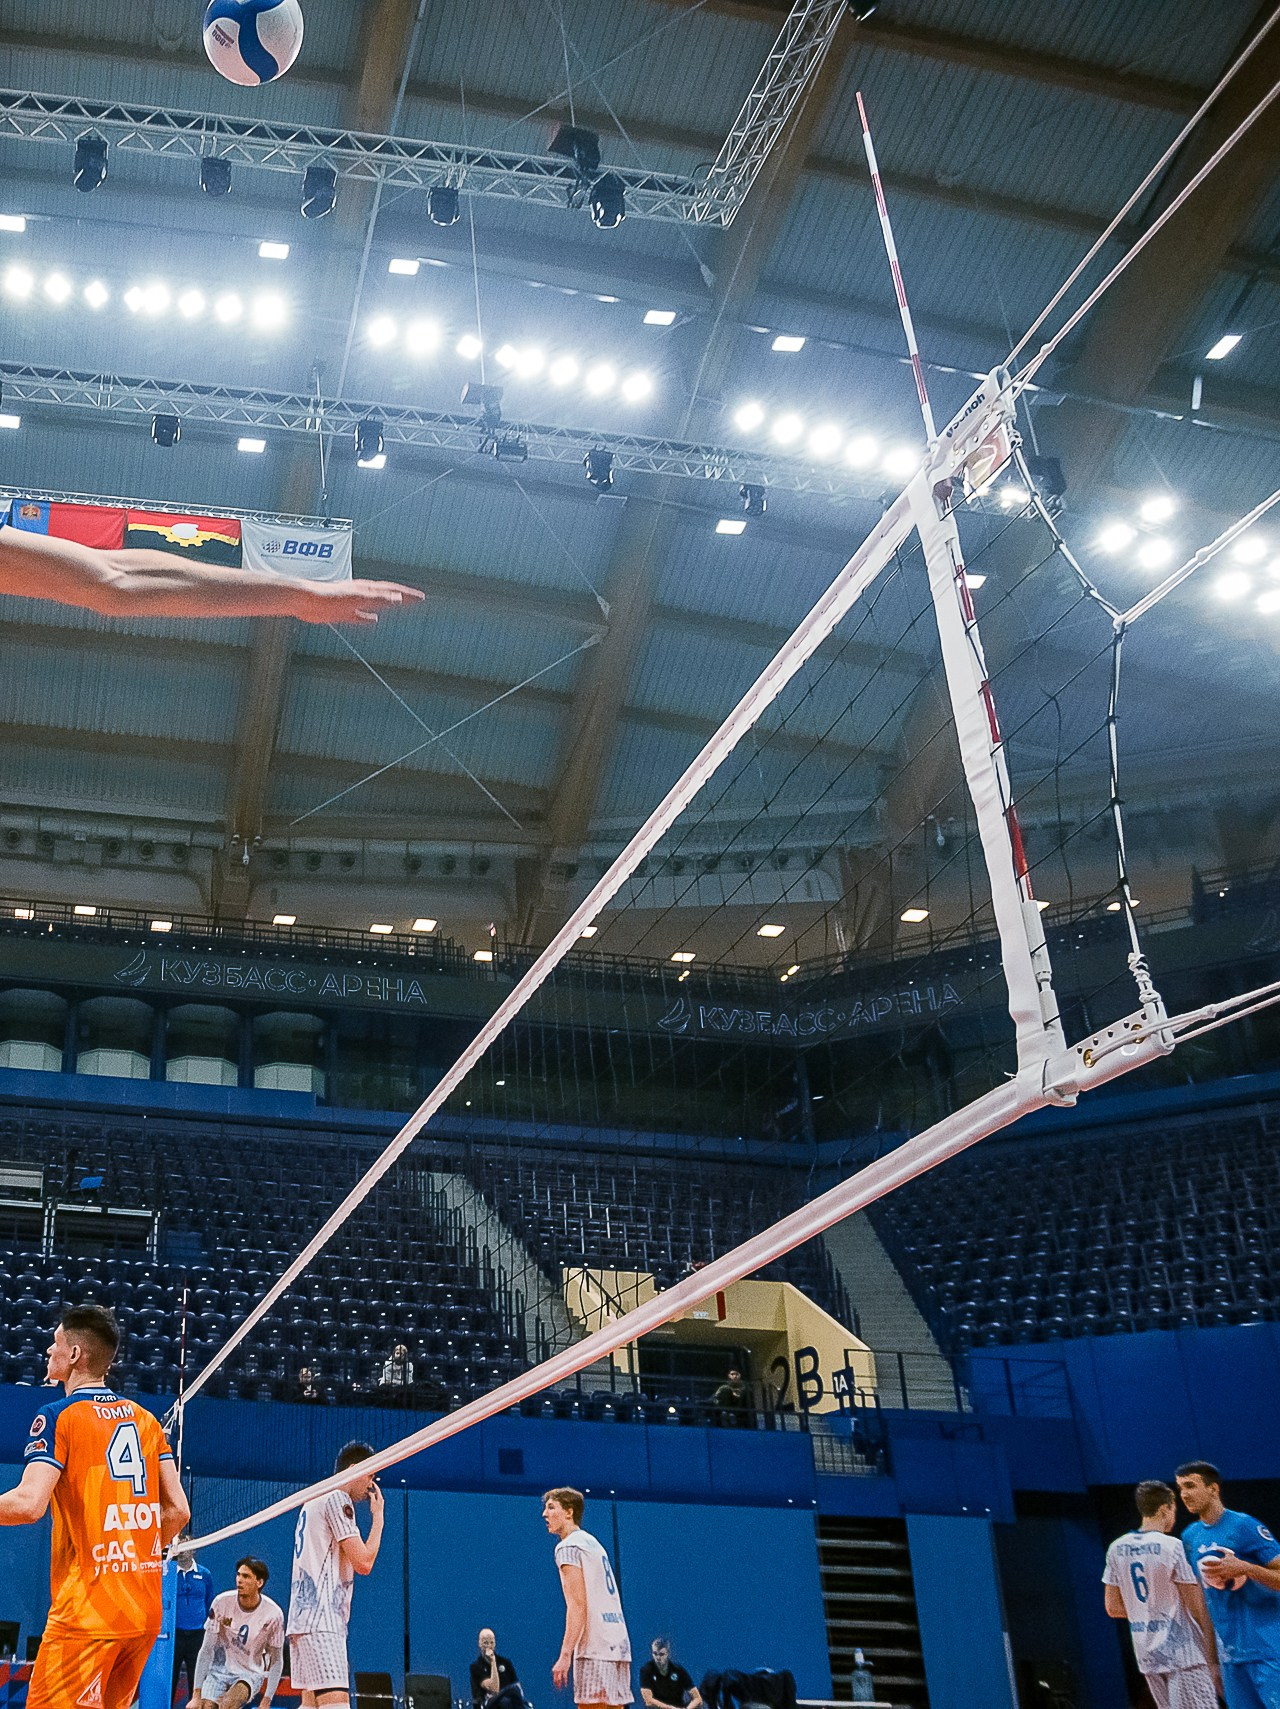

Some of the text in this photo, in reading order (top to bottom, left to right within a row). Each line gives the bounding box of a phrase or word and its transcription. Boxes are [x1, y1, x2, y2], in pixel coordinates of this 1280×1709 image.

[282, 540, 334, 559] ВФВ
[92, 1403, 134, 1420] ТОММ
[107, 1422, 147, 1496] 4
[92, 1540, 136, 1562] СДС
[602, 1555, 615, 1595] 8
[1130, 1561, 1149, 1603] 6
